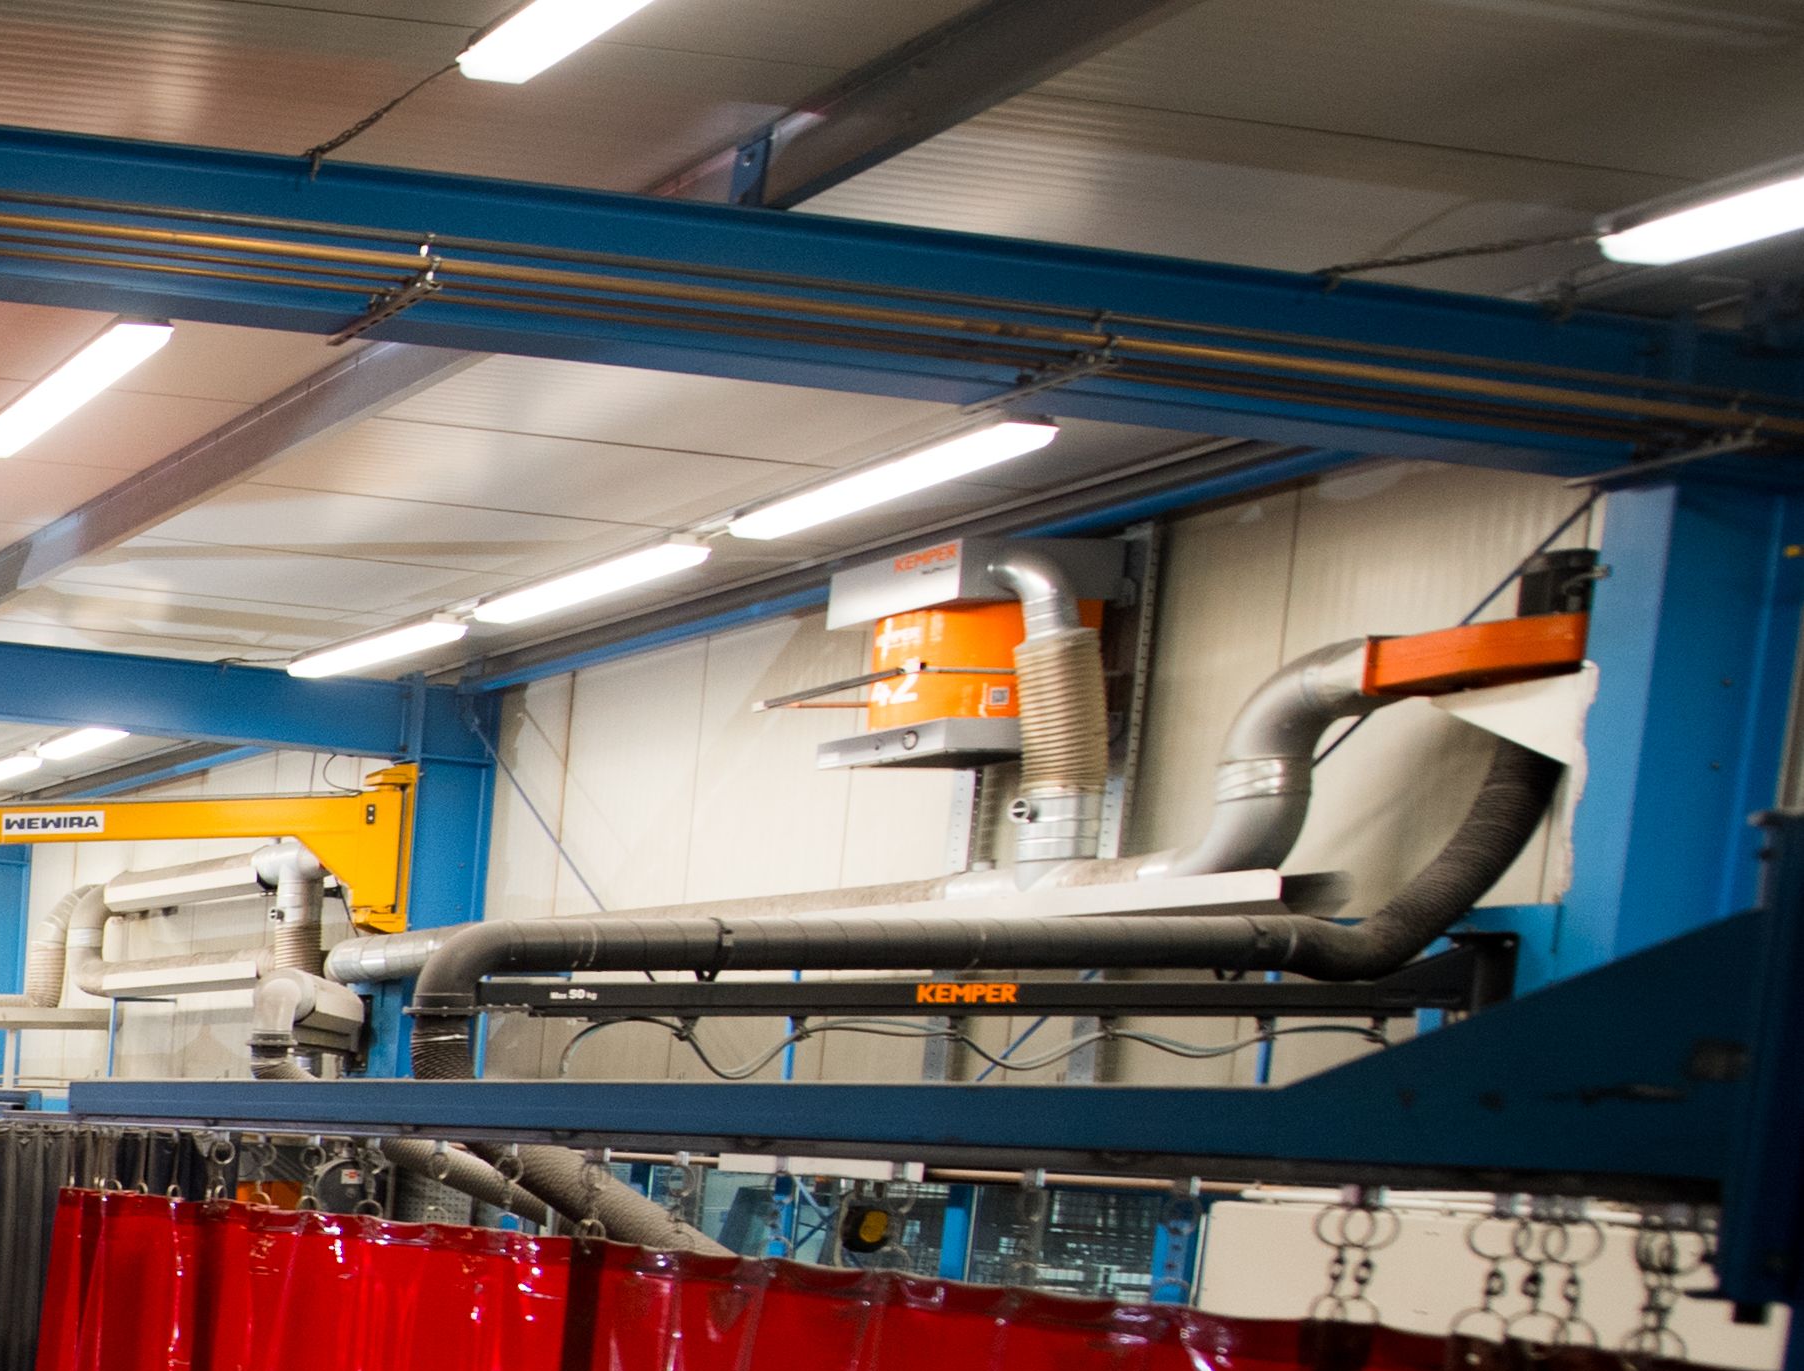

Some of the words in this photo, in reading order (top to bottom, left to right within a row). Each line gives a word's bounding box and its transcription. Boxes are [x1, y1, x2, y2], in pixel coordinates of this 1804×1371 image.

[893, 543, 958, 573] KEMPER
[4, 816, 99, 830] WEWIRA
[916, 982, 1018, 1004] KEMPER
